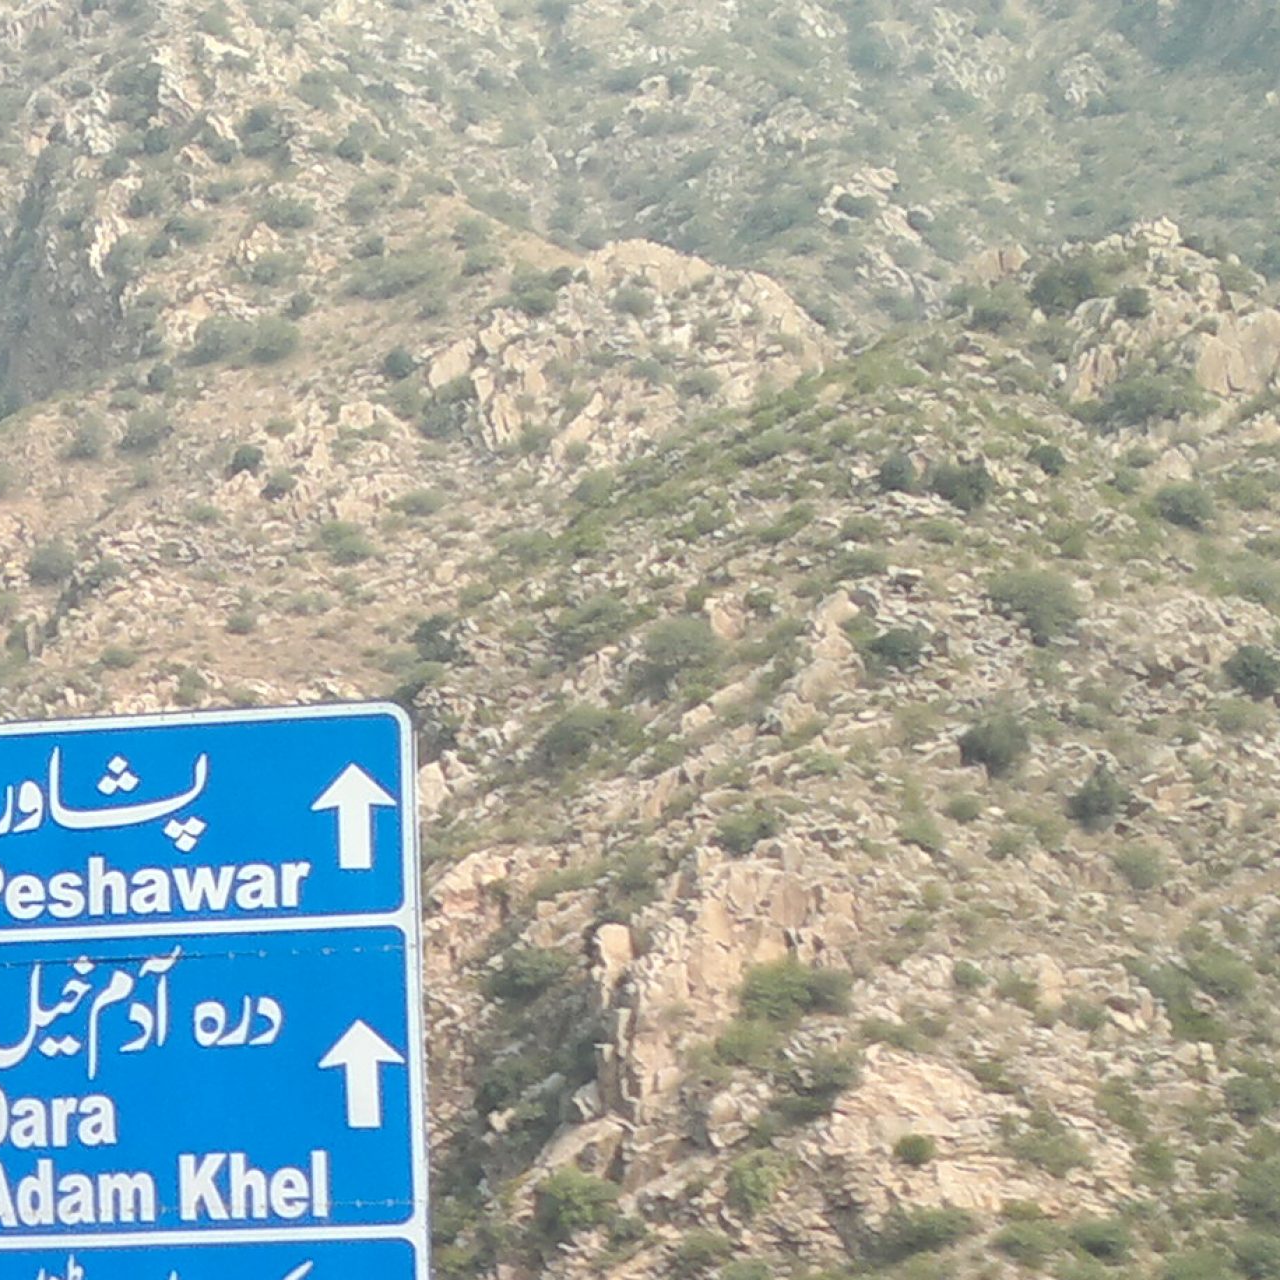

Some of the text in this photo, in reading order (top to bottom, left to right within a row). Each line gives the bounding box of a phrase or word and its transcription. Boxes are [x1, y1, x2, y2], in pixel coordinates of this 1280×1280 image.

[88, 946, 182, 1080] آدم
[194, 996, 282, 1046] درہ
[180, 1150, 329, 1221] Khel
